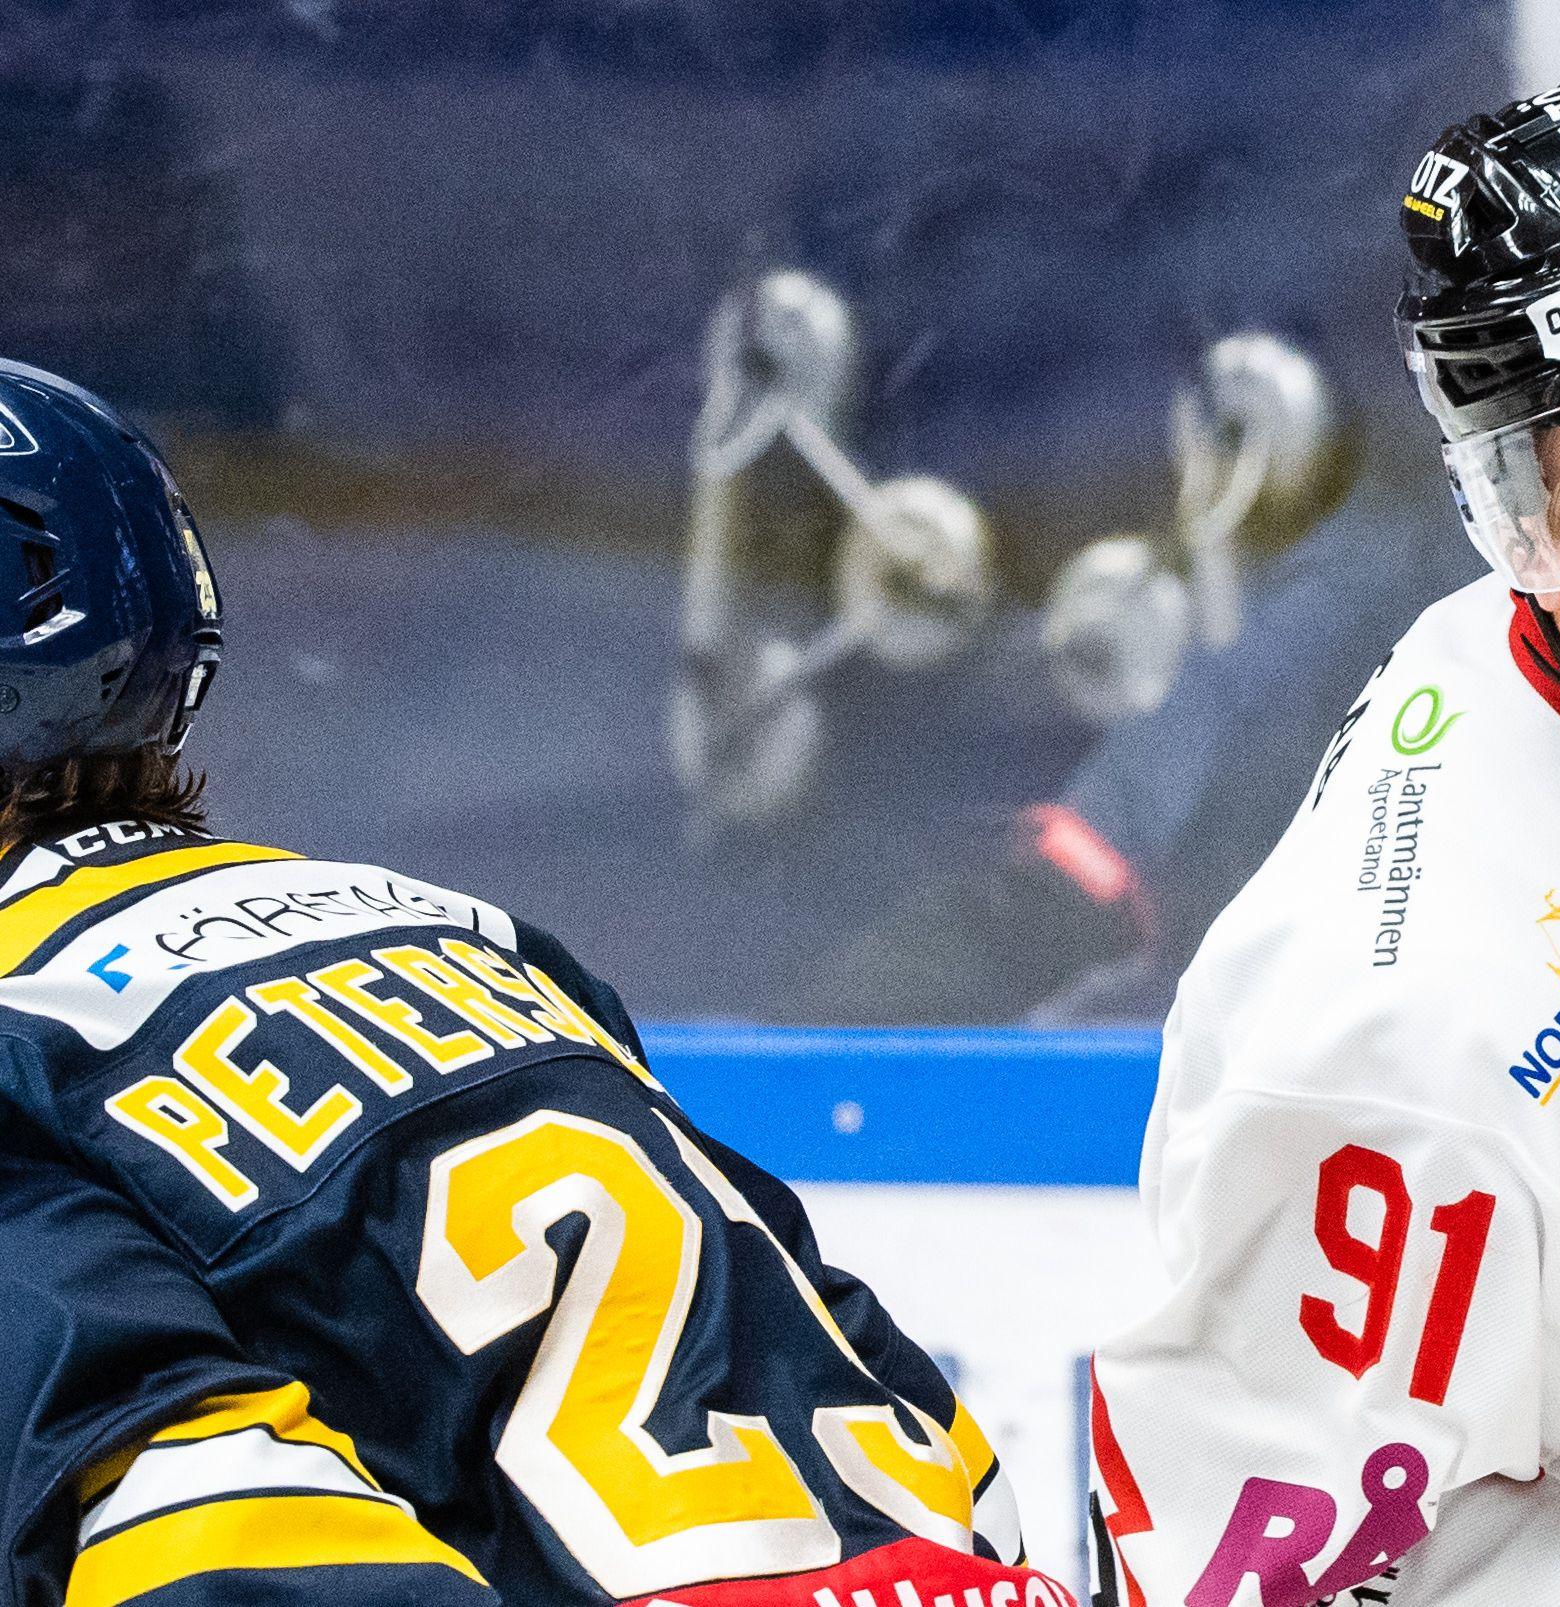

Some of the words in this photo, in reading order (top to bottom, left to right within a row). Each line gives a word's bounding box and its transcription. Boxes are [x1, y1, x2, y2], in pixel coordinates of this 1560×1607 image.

[55, 820, 185, 857] CCM
[1357, 768, 1402, 892] Agroetanol
[1373, 763, 1442, 967] Lantmännen
[1299, 1143, 1496, 1407] 91
